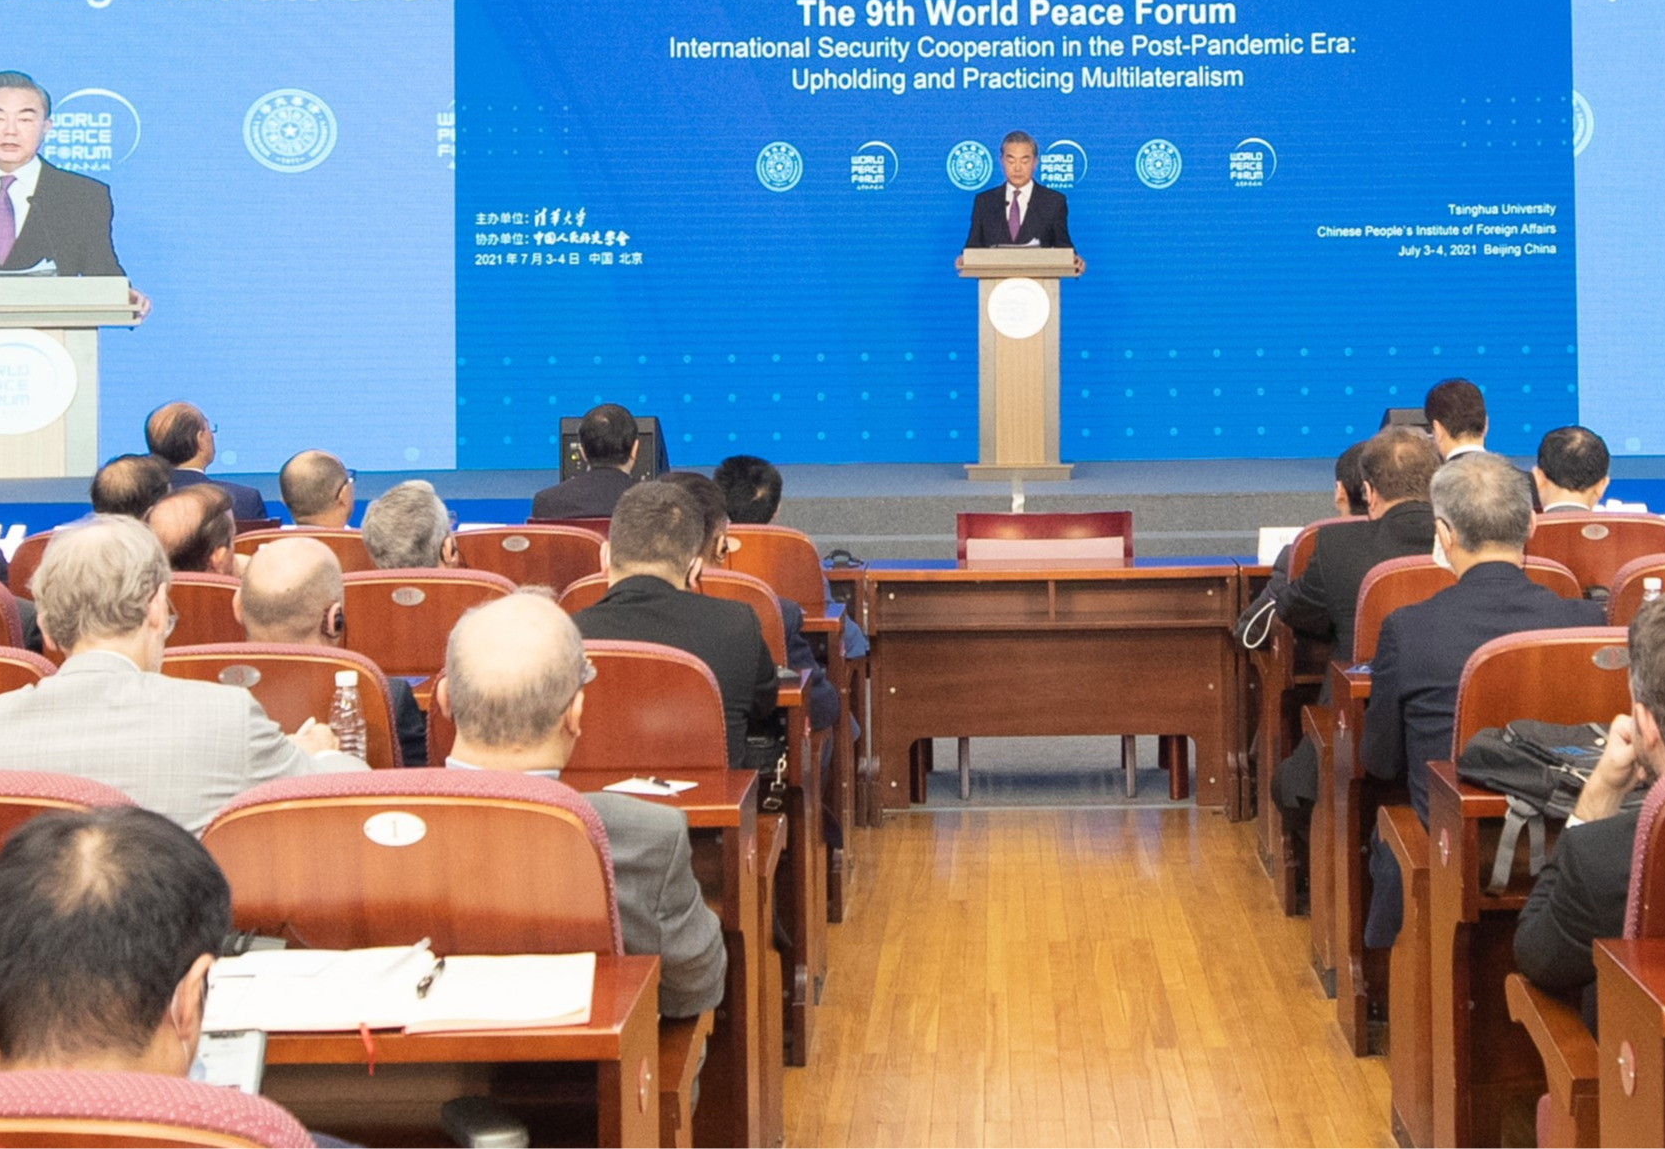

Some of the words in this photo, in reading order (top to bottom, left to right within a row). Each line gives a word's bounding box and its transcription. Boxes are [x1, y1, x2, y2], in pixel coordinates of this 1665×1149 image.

[669, 36, 811, 59] International
[817, 35, 910, 64] Security
[916, 35, 1055, 63] Cooperation
[1062, 35, 1082, 58] in
[1088, 34, 1125, 57] the
[1132, 32, 1304, 58] Post-Pandemic
[1310, 32, 1357, 55] Era:
[792, 67, 907, 96] Upholding
[913, 67, 956, 90] and
[962, 67, 1074, 95] Practicing
[1081, 65, 1245, 90] Multilateralism
[44, 128, 113, 144] PEACE
[850, 155, 885, 165] WORLD
[1040, 154, 1074, 164] WORLD
[1229, 151, 1264, 161] WORLD
[850, 164, 885, 175] PEACE
[1040, 163, 1074, 173] PEACE
[1229, 161, 1264, 171] PEACE
[1448, 204, 1499, 218] Tsinghua
[1501, 203, 1557, 216] University
[1316, 225, 1362, 238] Chinese
[1416, 224, 1460, 237] Institute
[1461, 223, 1474, 236] of
[1476, 223, 1519, 238] Foreign
[1520, 223, 1557, 236] Affairs
[1398, 244, 1421, 259] July
[1423, 244, 1448, 258] 3-4,
[1450, 243, 1477, 257] 2021
[1483, 243, 1522, 258] Beijing
[1523, 242, 1557, 255] China
[588, 252, 614, 265] 中国
[618, 252, 644, 265] 北京
